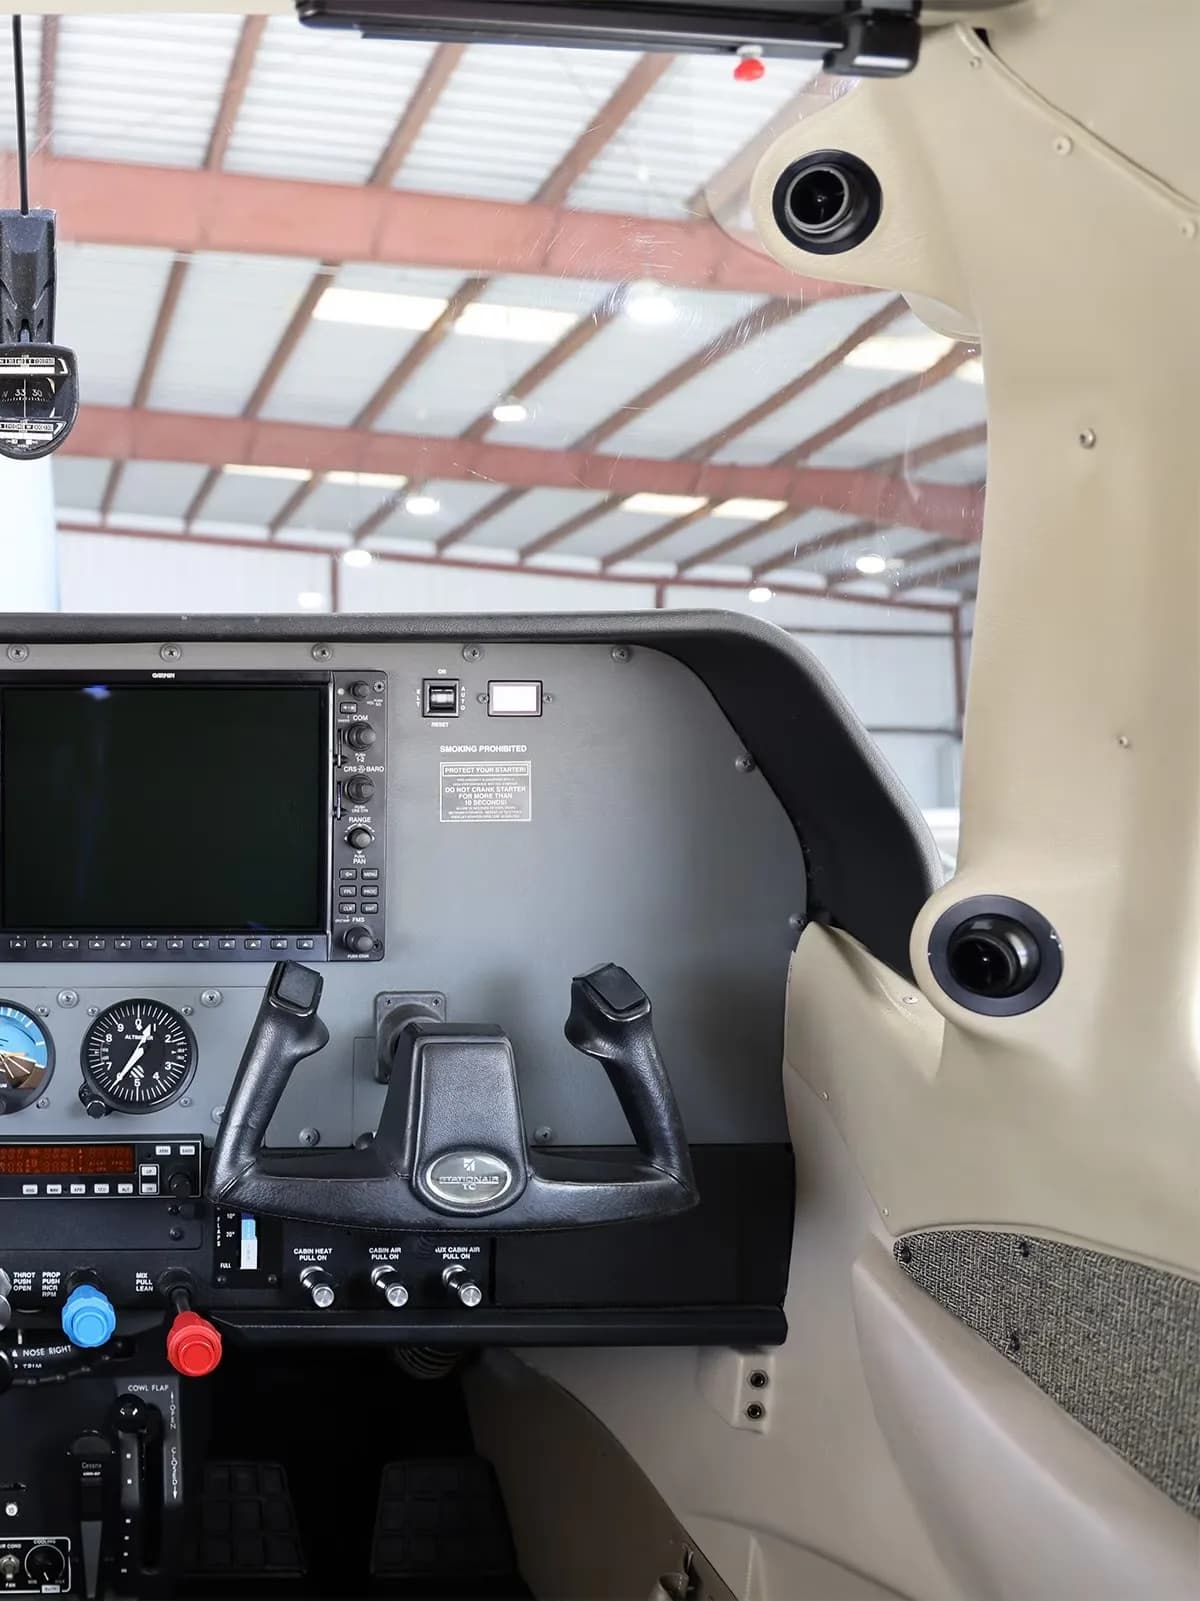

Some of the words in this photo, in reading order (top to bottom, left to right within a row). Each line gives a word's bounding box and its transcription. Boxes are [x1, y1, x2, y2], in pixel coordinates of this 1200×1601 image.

[15, 389, 26, 397] 33
[32, 389, 43, 397] 30
[117, 1024, 124, 1032] 9
[106, 1034, 113, 1042] 8
[165, 1034, 172, 1043] 2
[106, 1062, 112, 1070] 7
[165, 1062, 172, 1070] 3
[134, 1079, 141, 1087] 5
[23, 1348, 45, 1357] NOSE
[49, 1345, 71, 1354] RIGHT
